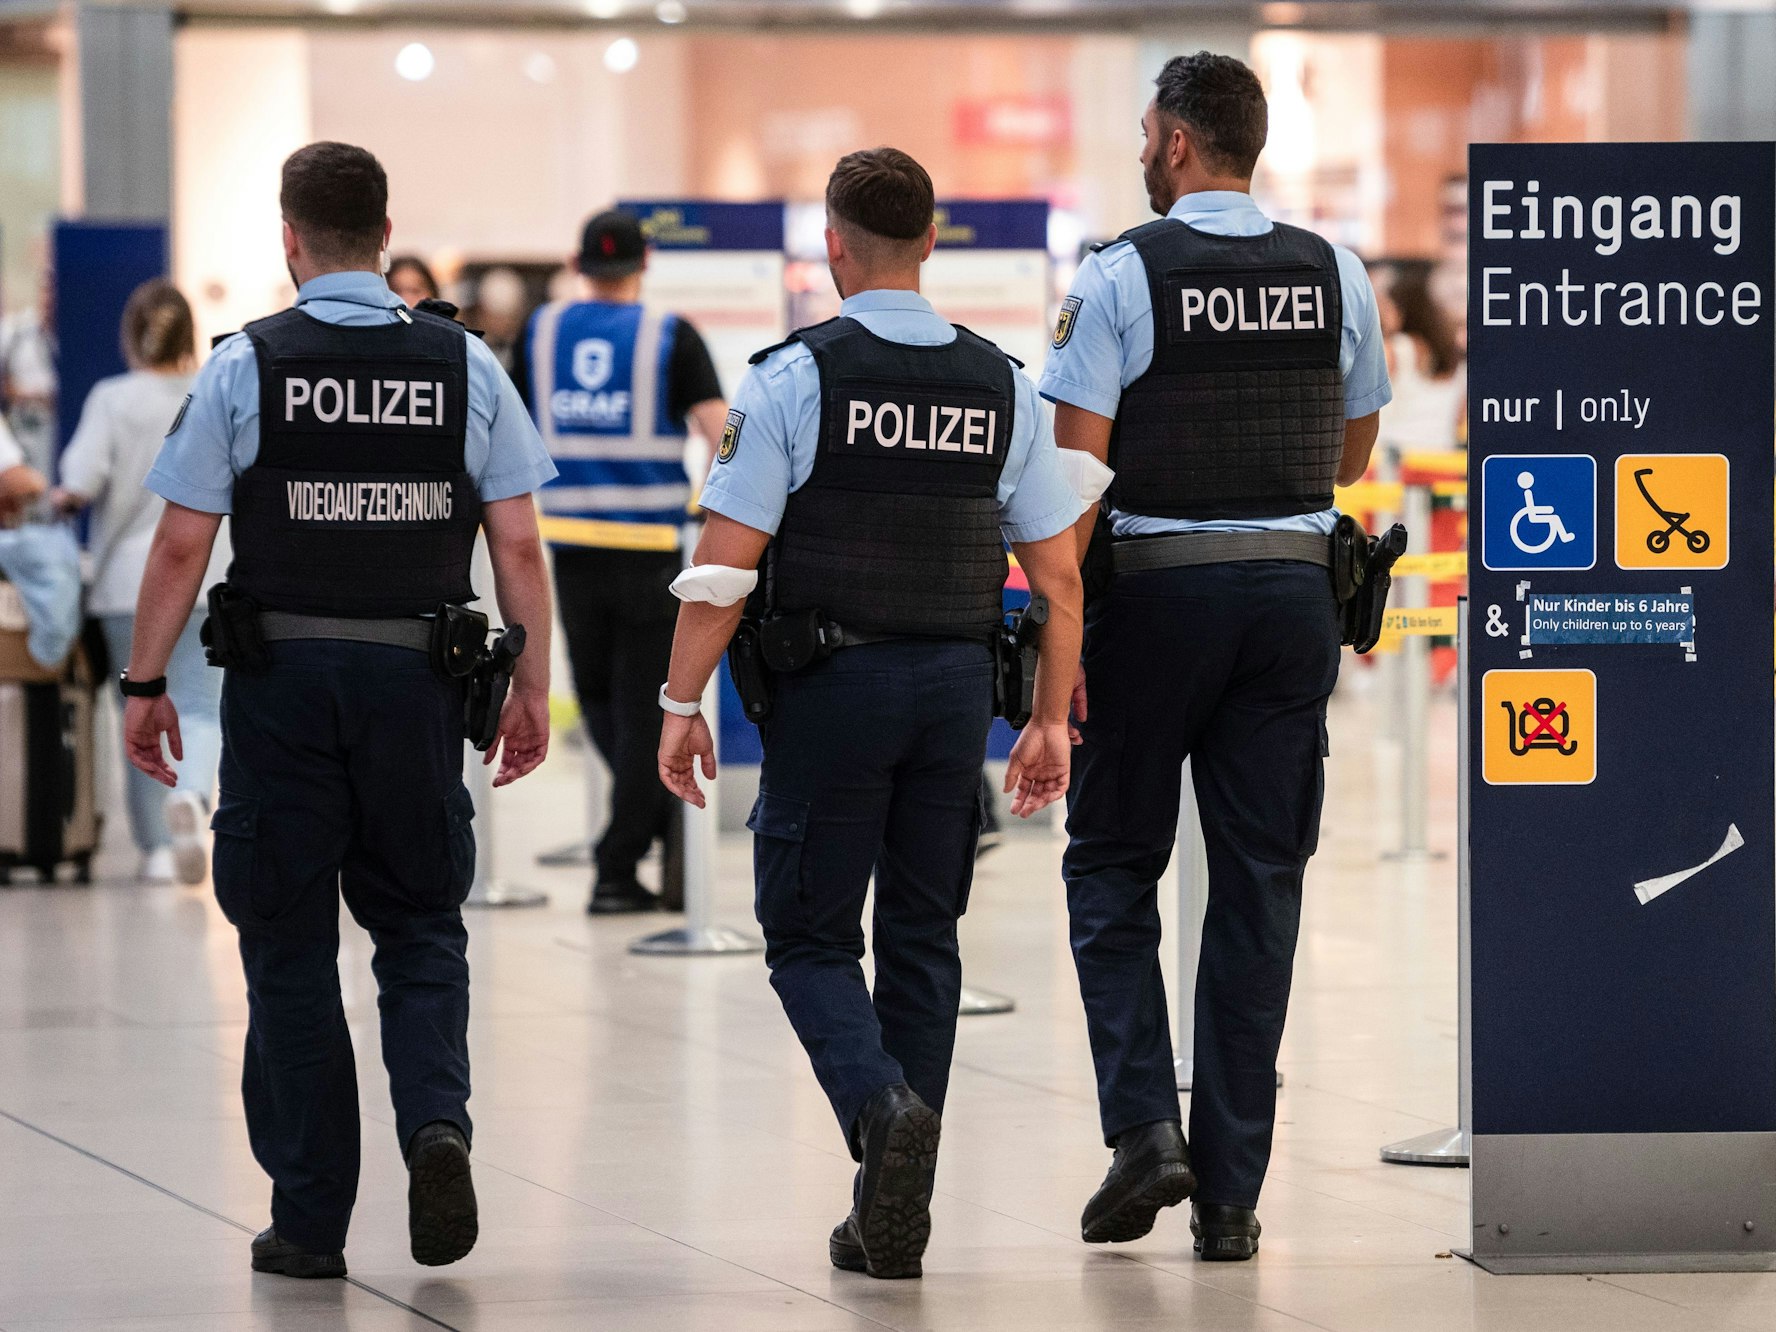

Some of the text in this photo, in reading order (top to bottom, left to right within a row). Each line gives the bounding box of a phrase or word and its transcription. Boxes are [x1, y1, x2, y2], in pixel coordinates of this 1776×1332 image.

[1483, 180, 1741, 256] Eingang
[1181, 285, 1325, 332] POLIZEI
[1483, 267, 1761, 326] Entrance
[285, 377, 443, 426] POLIZEI
[1482, 397, 1540, 423] nur
[1580, 389, 1651, 429] only
[846, 400, 996, 455] POLIZEI
[287, 481, 452, 521] VIDEOAUFZEICHNUNG
[1485, 604, 1509, 638] &
[1532, 618, 1686, 633] Only children up to 6 years
[1533, 598, 1690, 613] Nur Kinder bis 6 Jahre
